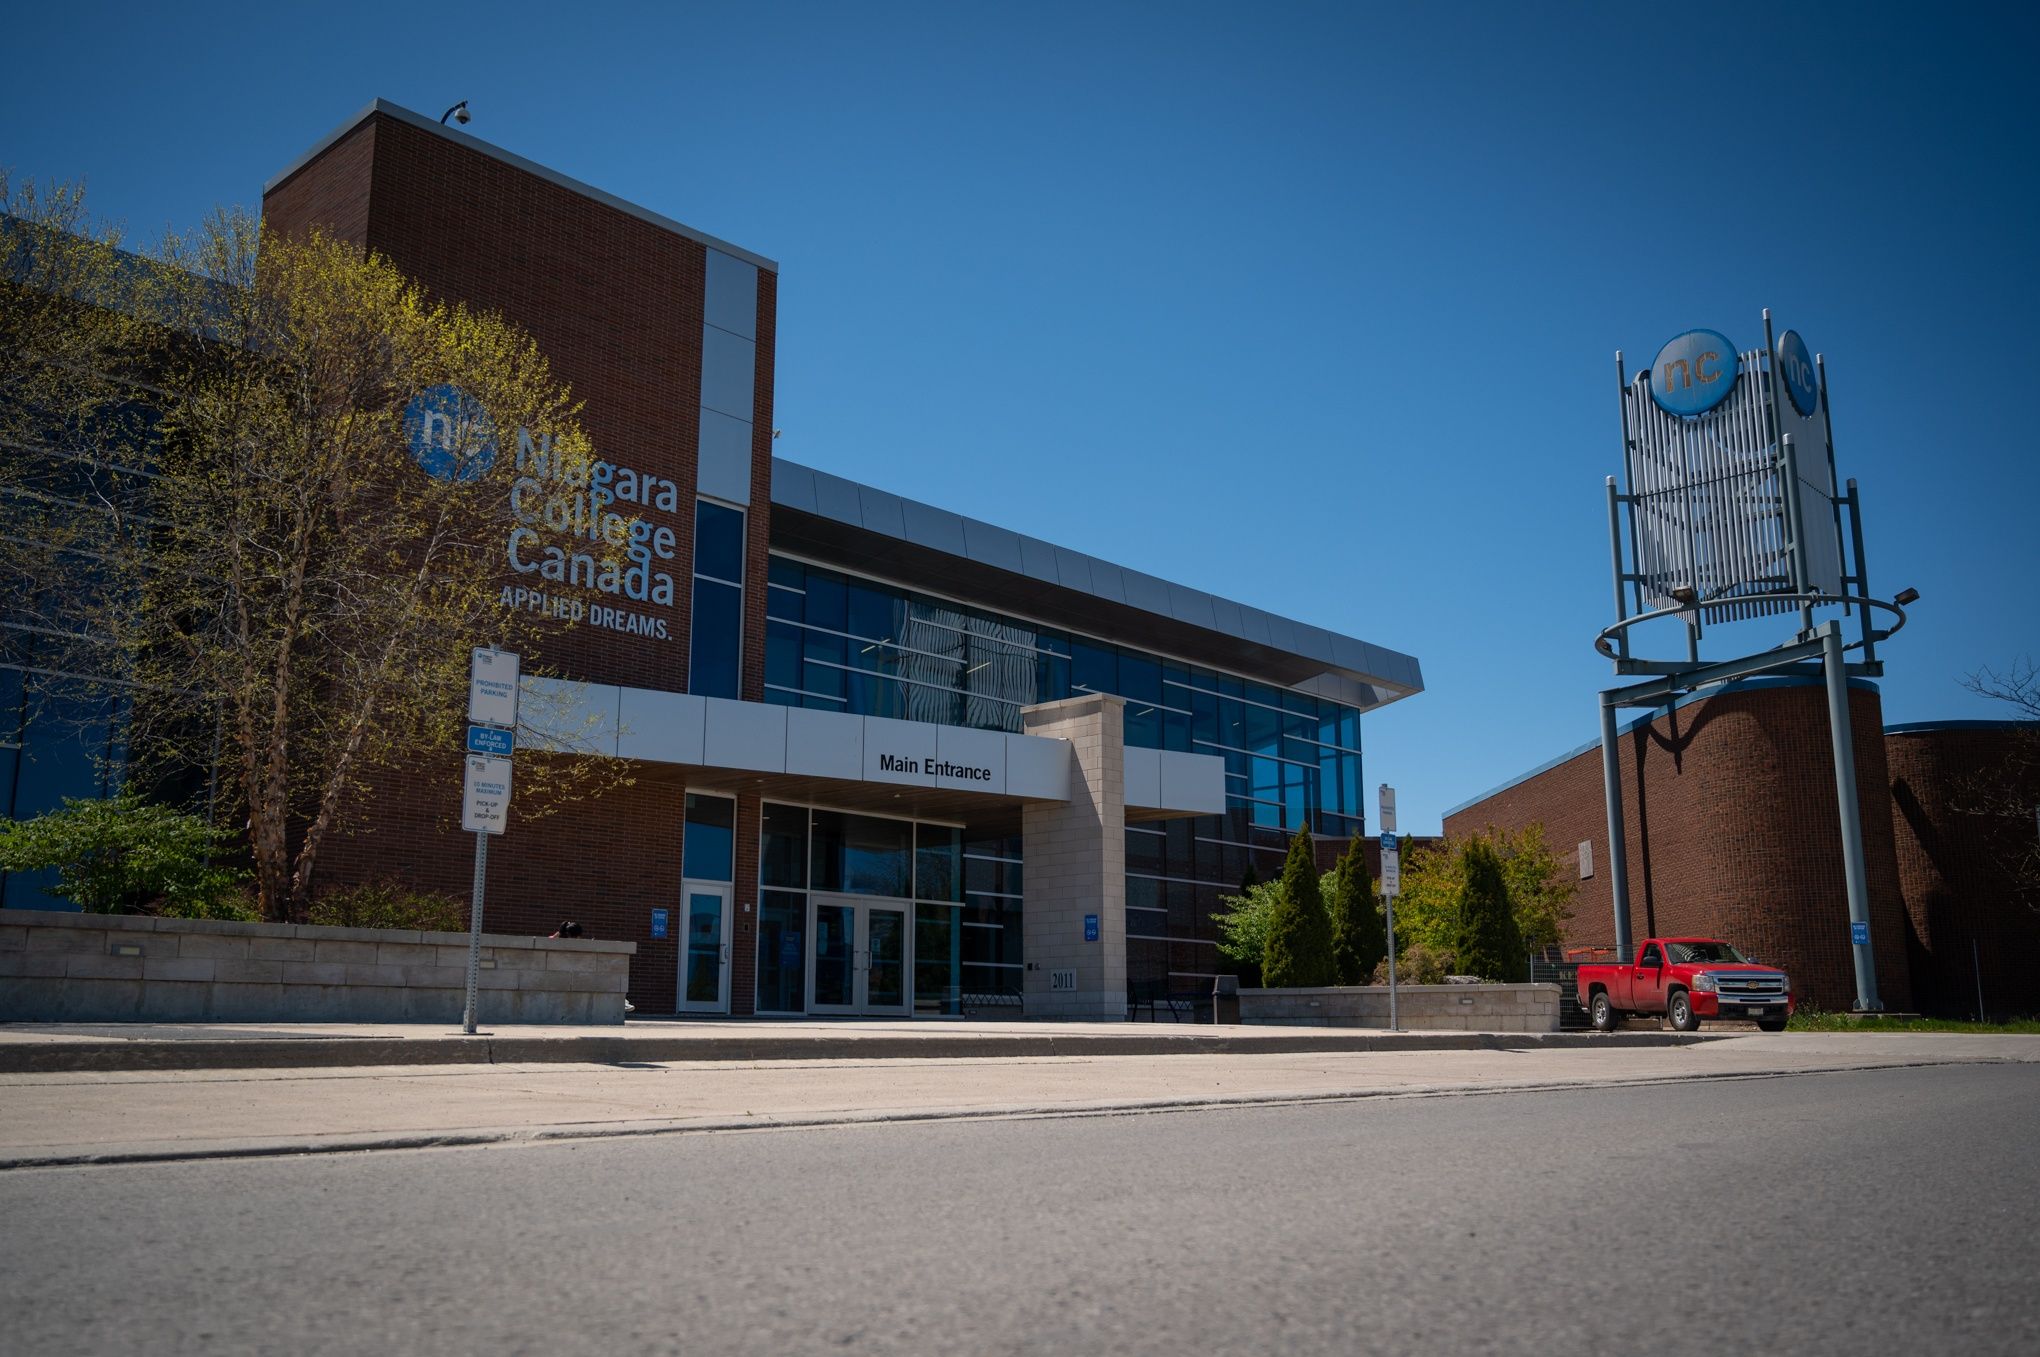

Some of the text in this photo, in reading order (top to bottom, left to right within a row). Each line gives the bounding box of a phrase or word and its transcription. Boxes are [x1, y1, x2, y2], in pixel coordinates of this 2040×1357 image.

[1664, 351, 1723, 393] nc
[1789, 351, 1812, 393] nc
[515, 426, 678, 514] Niagara
[510, 476, 677, 563] College
[508, 527, 674, 607] Canada
[500, 585, 673, 641] APPLIED DREAMS.
[476, 679, 514, 691] PROHIBITED
[480, 687, 508, 698] PARKING
[474, 739, 507, 749] ENFORCED
[480, 732, 502, 742] BY-LAW
[880, 754, 991, 781] Main Entrance
[476, 800, 498, 808] PICK-UP
[474, 812, 500, 820] DROP-OFF
[1052, 972, 1073, 989] 2011
